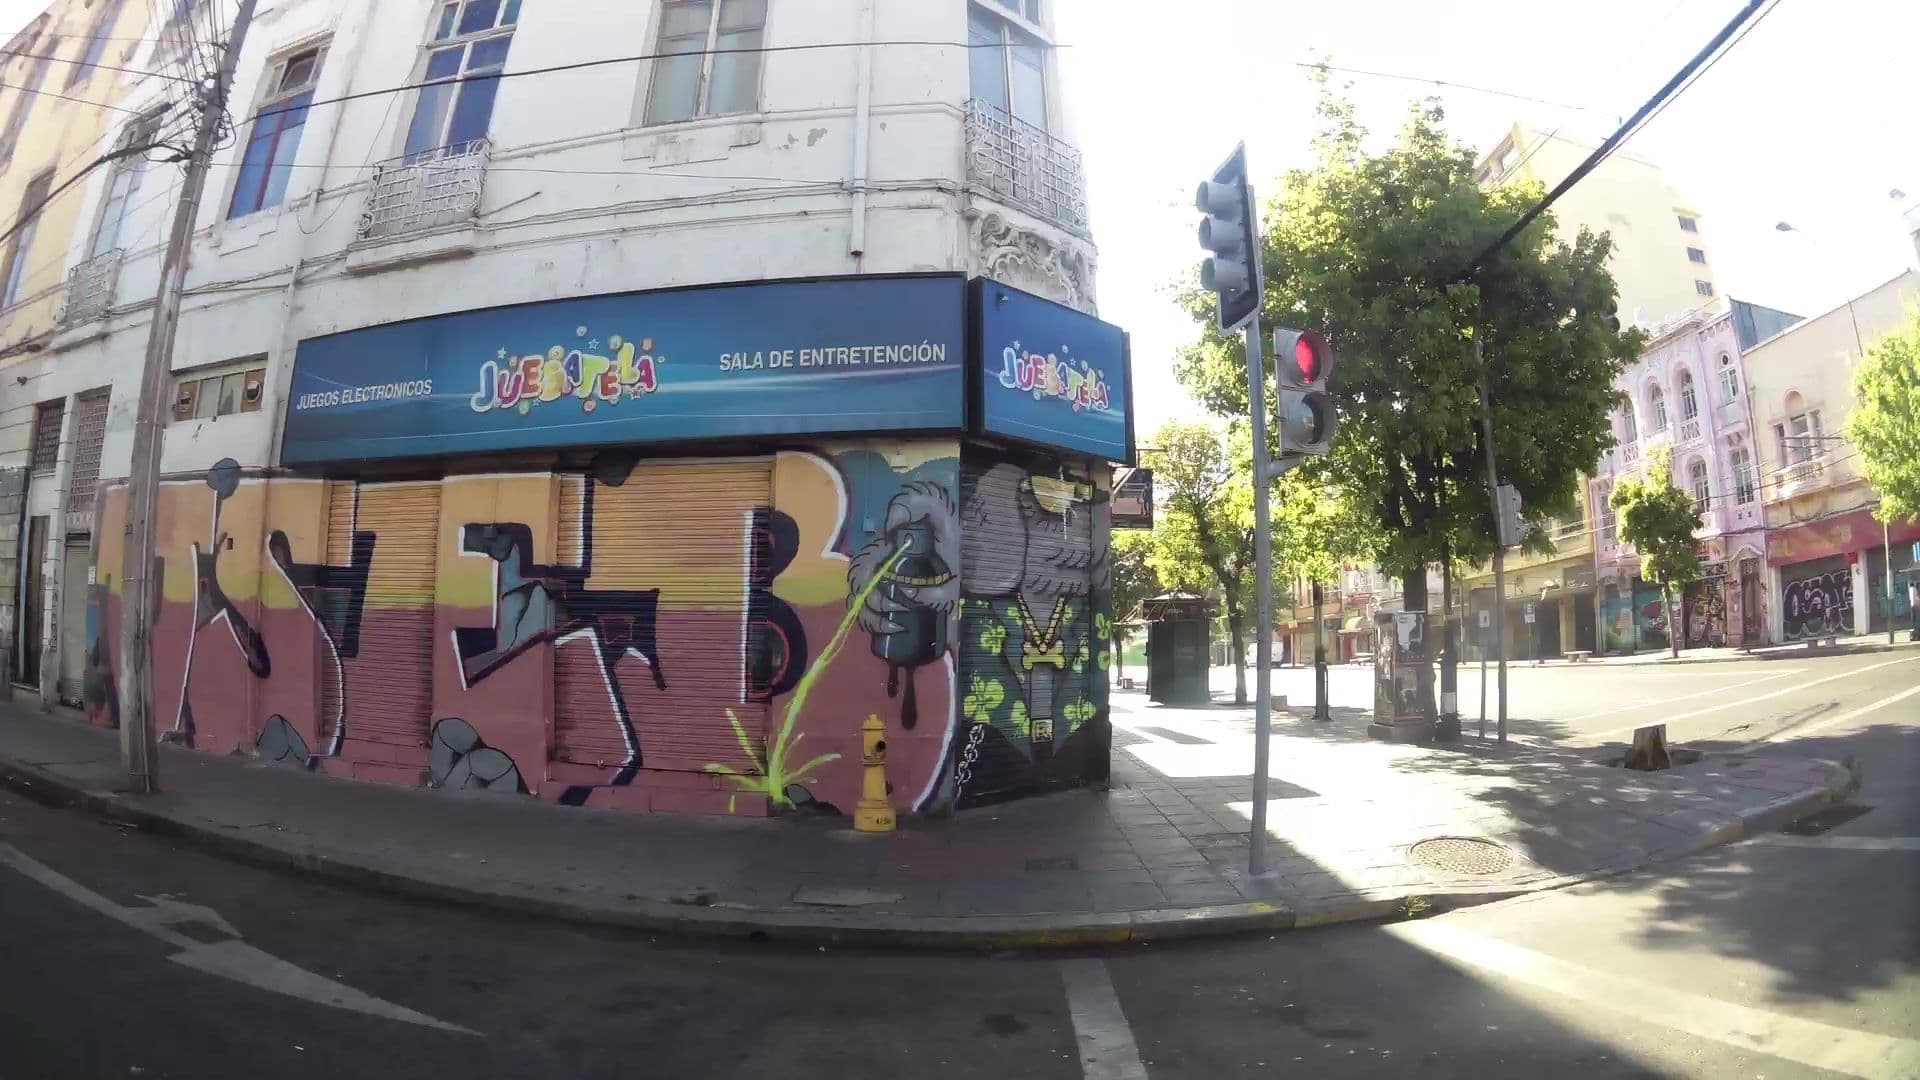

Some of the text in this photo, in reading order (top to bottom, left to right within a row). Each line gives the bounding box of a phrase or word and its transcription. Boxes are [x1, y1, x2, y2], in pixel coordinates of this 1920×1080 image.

[719, 339, 946, 371] SALA DE ENTRETENCIÓN
[296, 379, 433, 410] JUEGOS ELECTRONICOS
